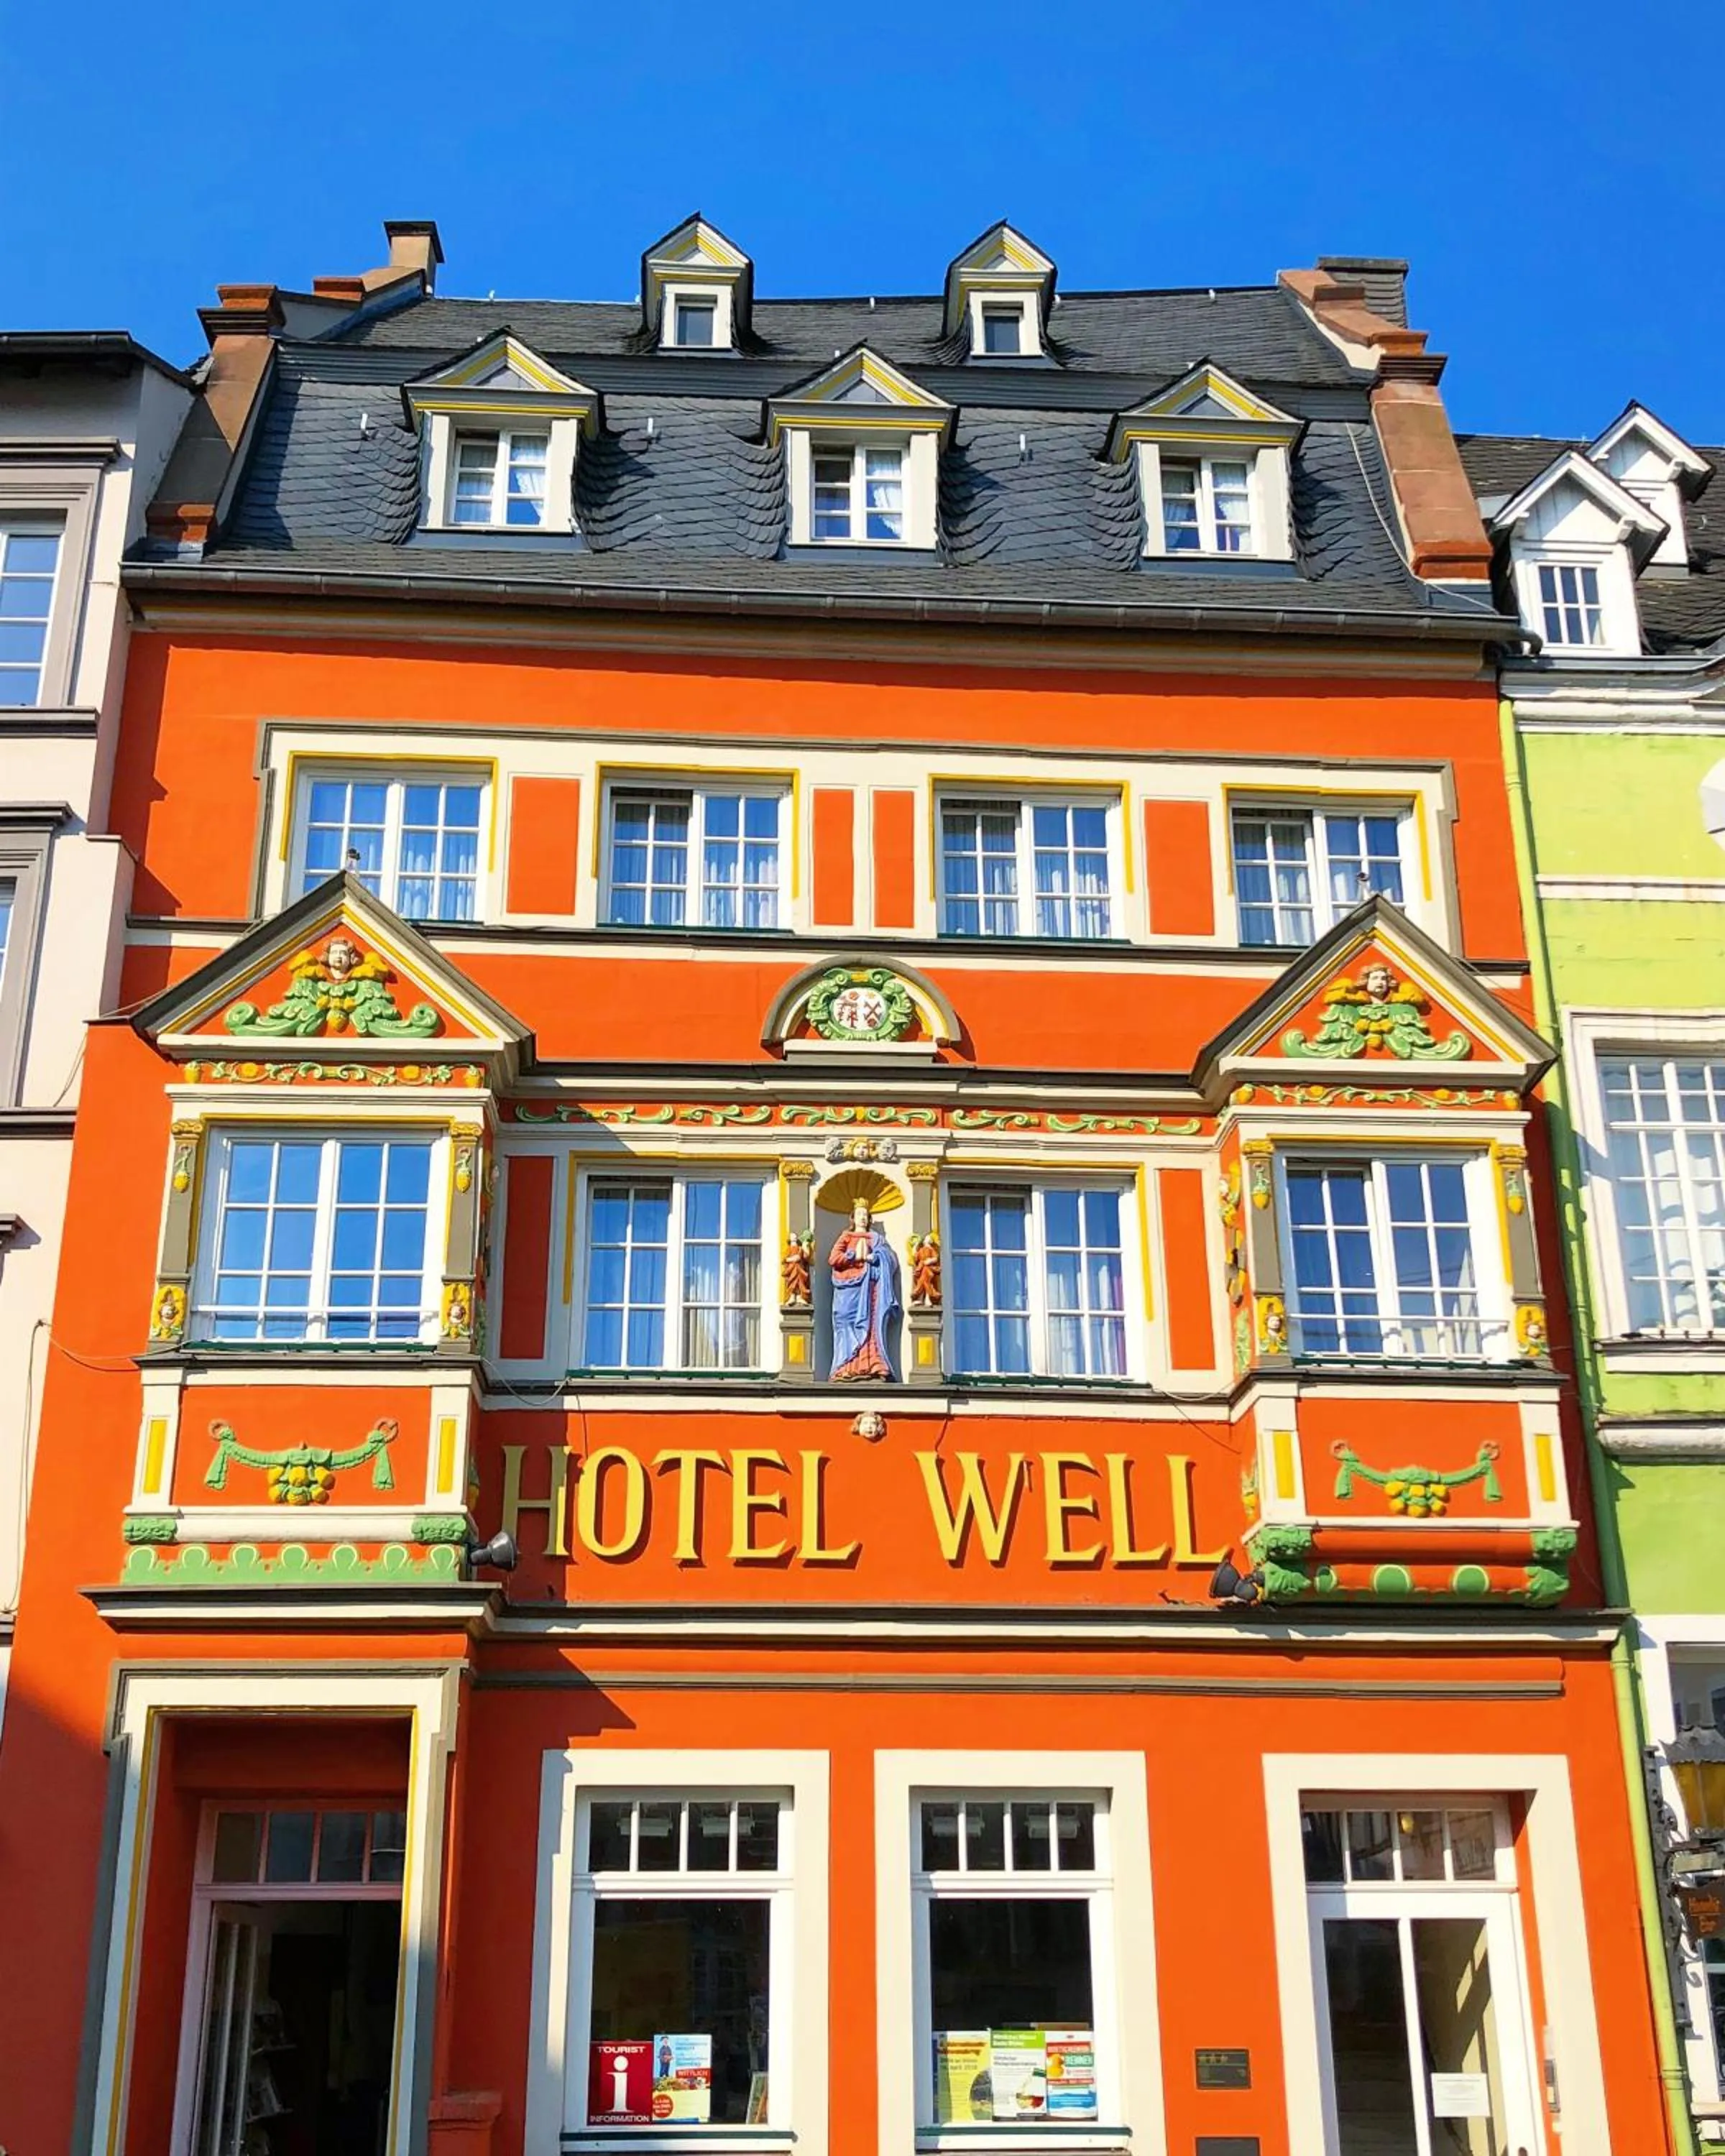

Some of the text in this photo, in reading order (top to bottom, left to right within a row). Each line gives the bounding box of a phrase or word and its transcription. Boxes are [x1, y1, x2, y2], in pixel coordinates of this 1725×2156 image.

[502, 1445, 1230, 1564] HOTEL WELL
[677, 2068, 709, 2077] WITTLICH
